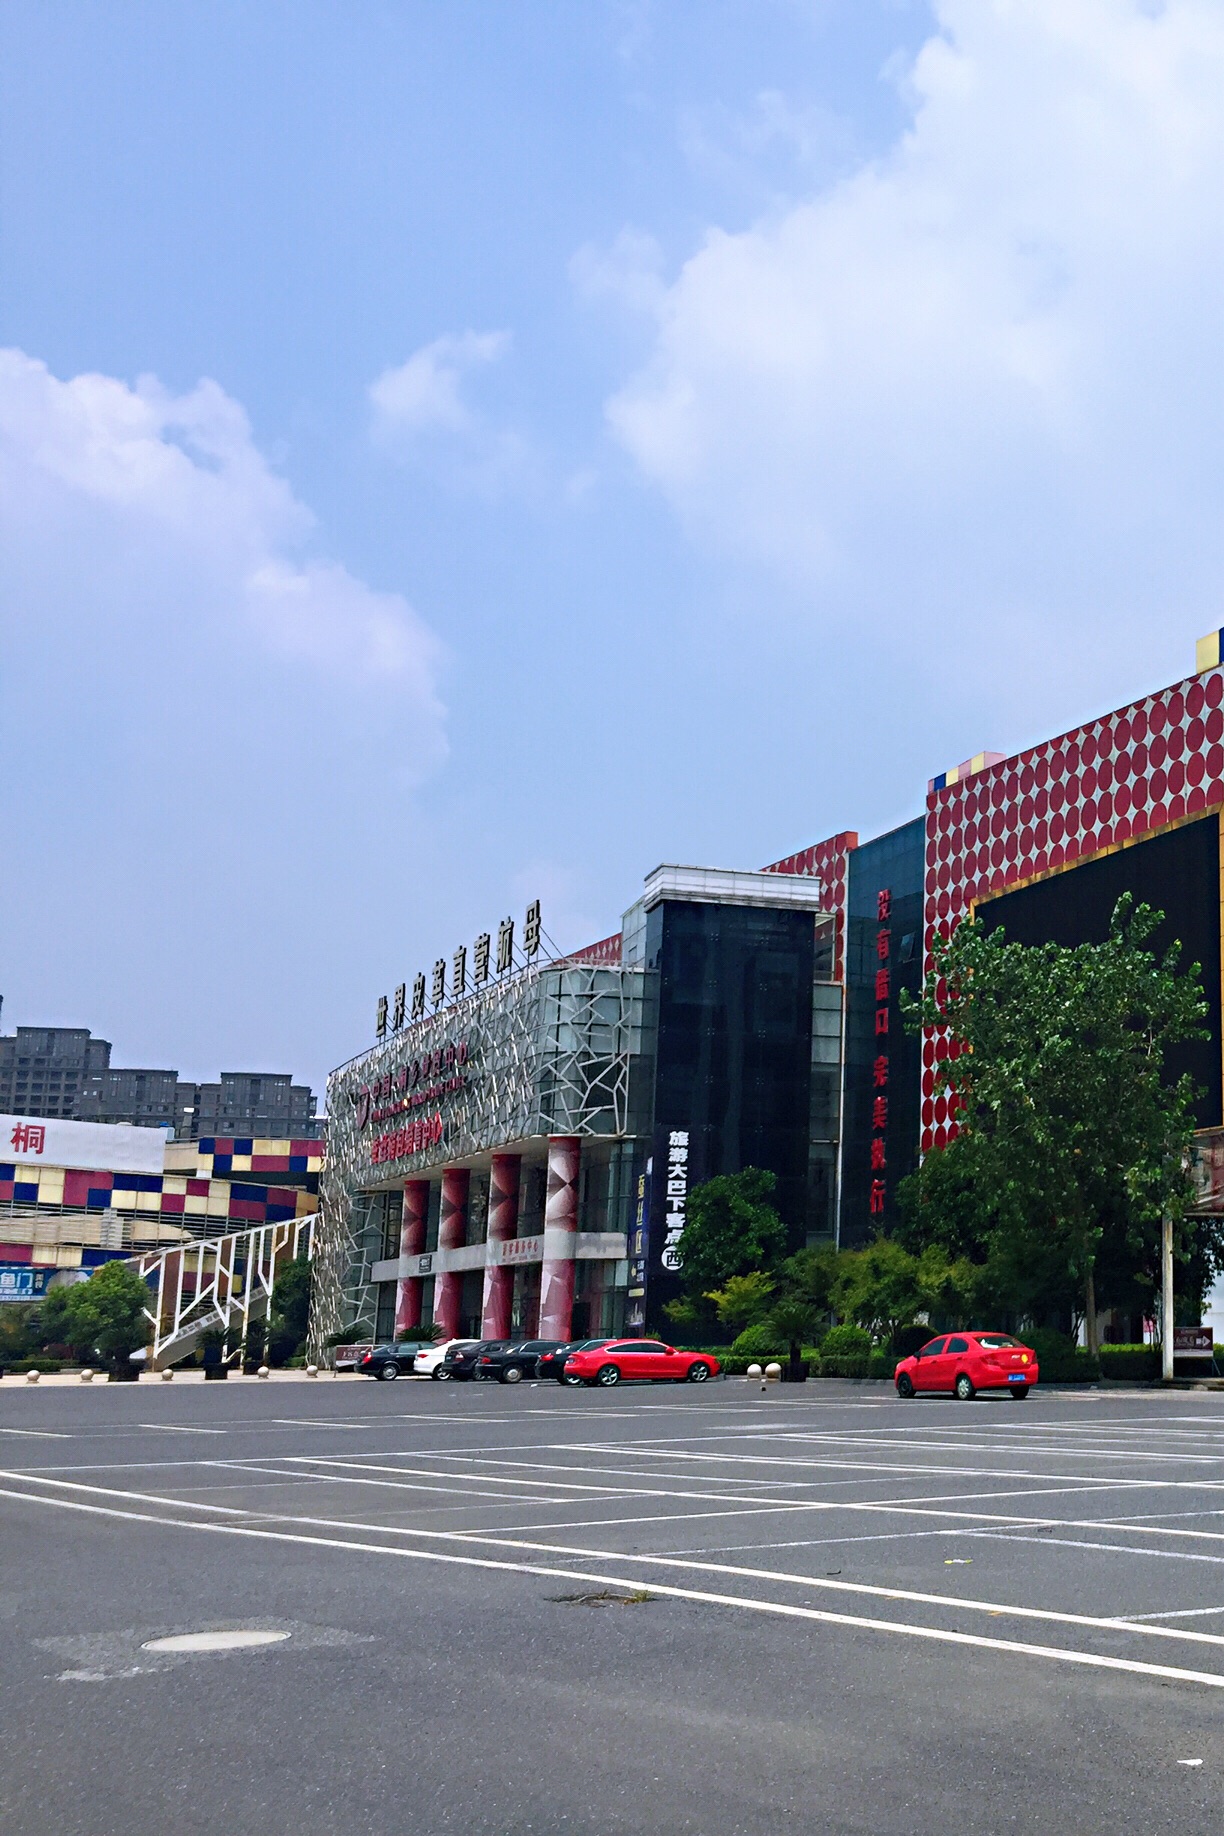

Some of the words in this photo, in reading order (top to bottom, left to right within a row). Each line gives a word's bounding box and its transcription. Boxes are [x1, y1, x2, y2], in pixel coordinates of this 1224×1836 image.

[375, 899, 541, 1038] 世界皮革直营航母
[10, 1121, 46, 1155] 桐
